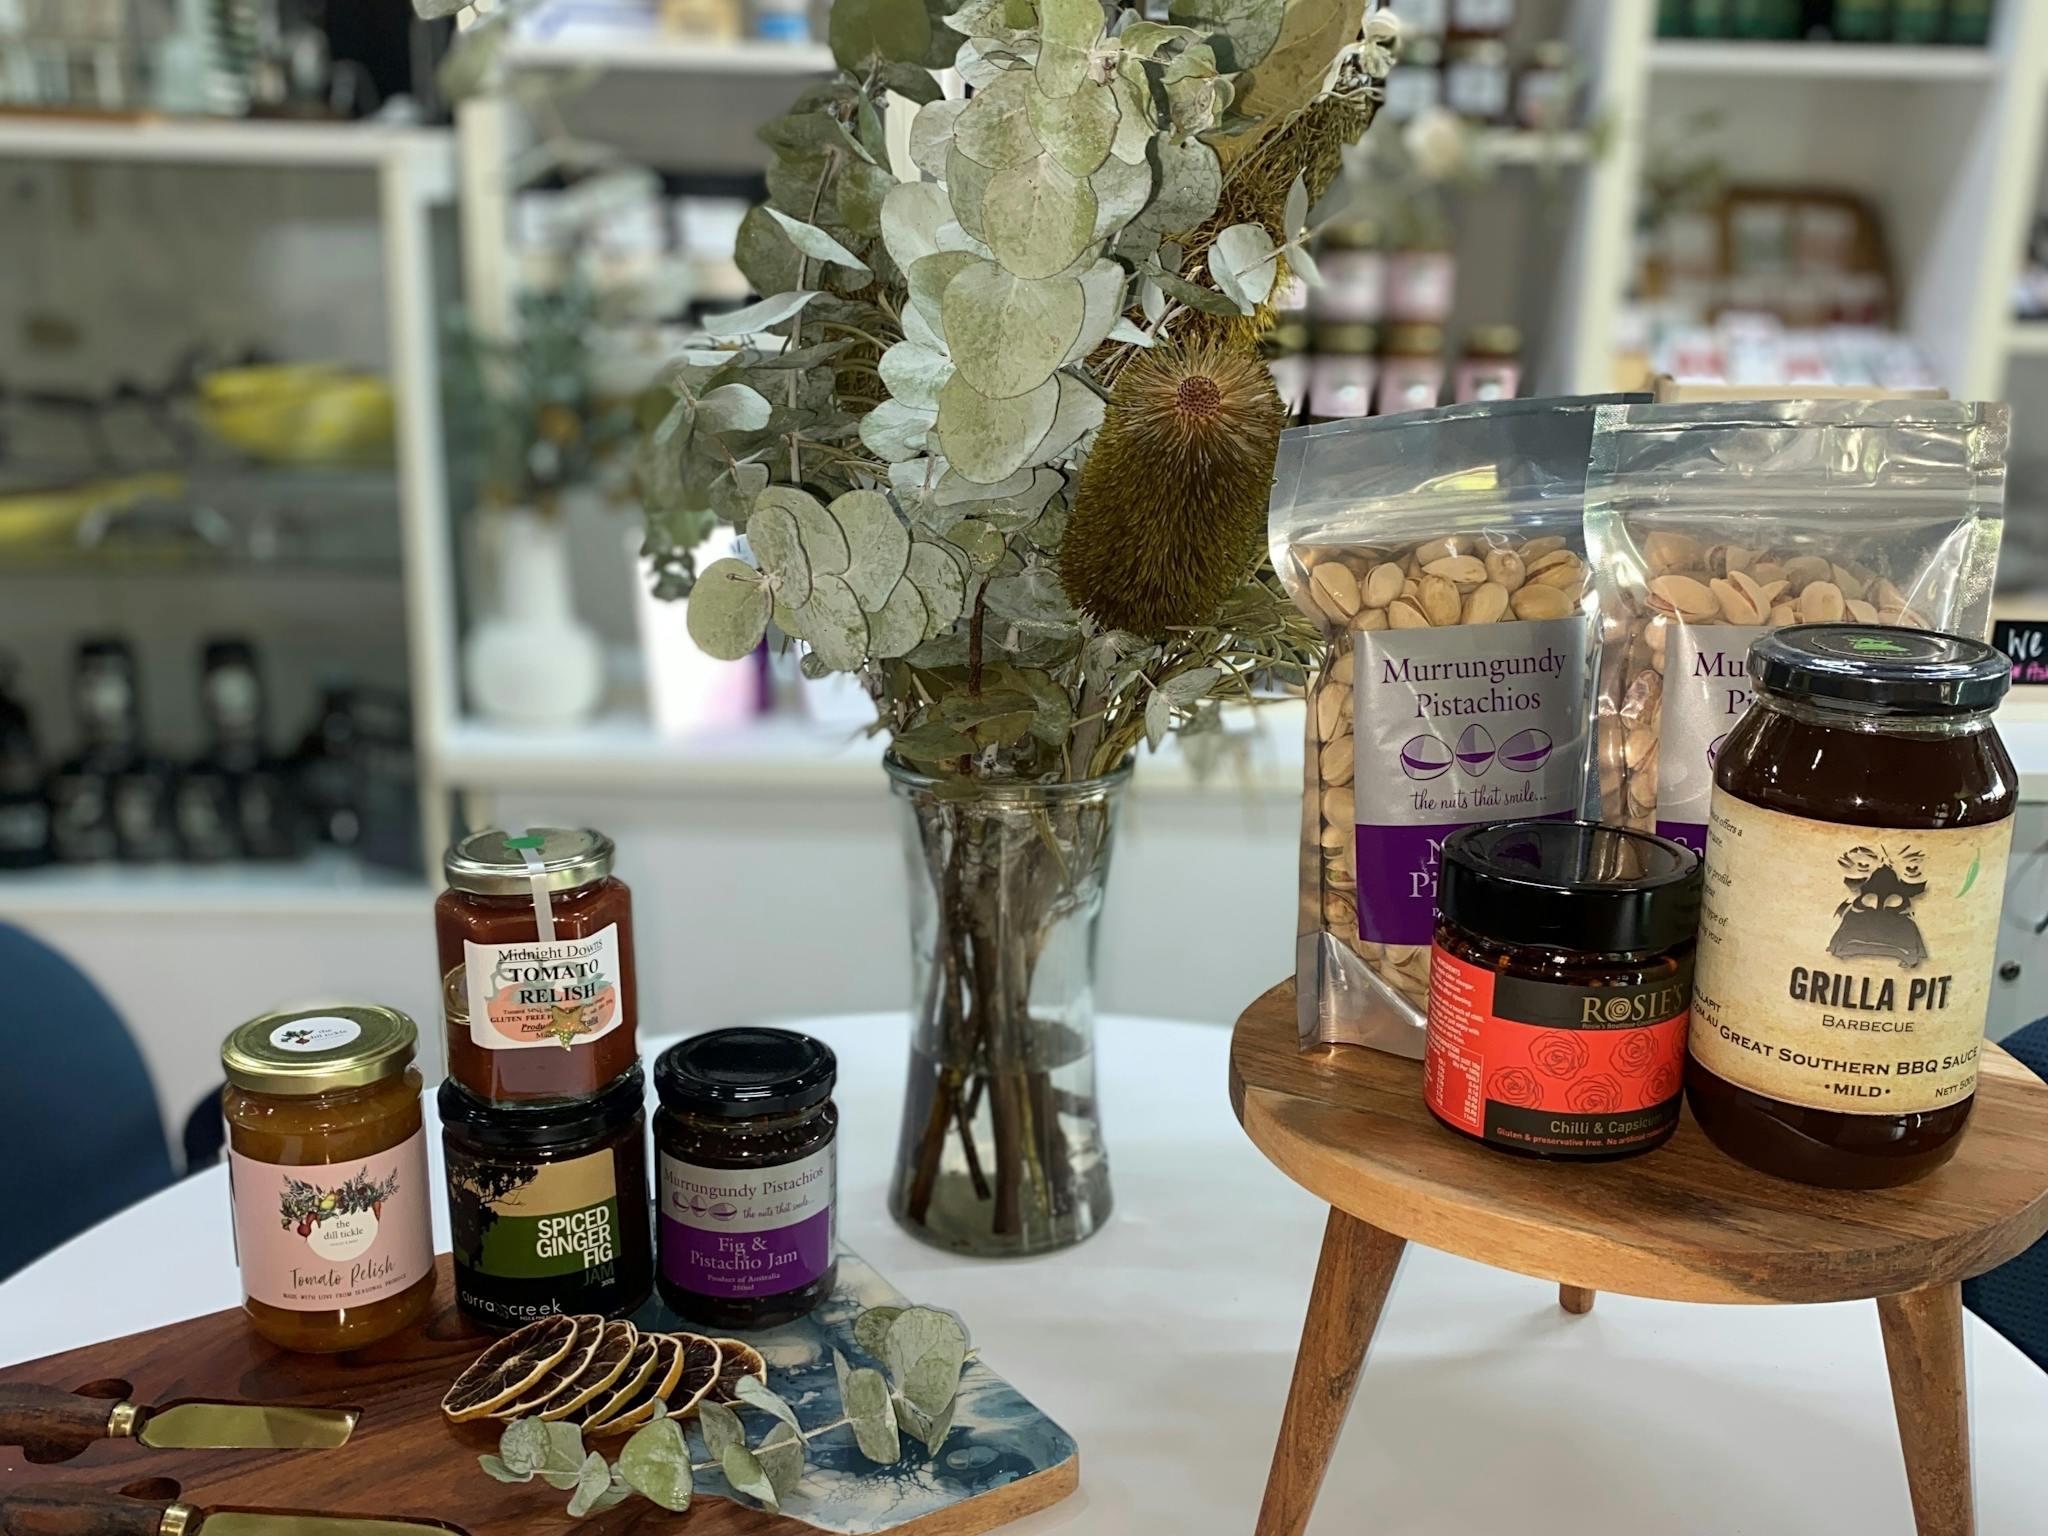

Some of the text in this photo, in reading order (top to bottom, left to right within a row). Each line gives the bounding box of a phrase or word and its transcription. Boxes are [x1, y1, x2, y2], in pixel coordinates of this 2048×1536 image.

[1382, 647, 1567, 684] Murrungundy
[1413, 687, 1541, 718] Pistachios
[1409, 788, 1437, 811] the
[1439, 788, 1469, 809] nuts
[1470, 784, 1502, 808] that
[1737, 828, 1743, 837] a
[498, 941, 603, 961] Midnight Downs
[508, 958, 599, 982] TOMATO
[520, 982, 596, 1004] RELISH
[1790, 966, 1952, 1011] GRILLA PIT
[1580, 983, 1683, 1023] ROSIE'S
[490, 1015, 522, 1024] GLUTEN
[525, 1014, 547, 1022] FREE
[1896, 1059, 1938, 1075] BBQ
[1550, 1120, 1589, 1135] Chilli
[1593, 1122, 1604, 1135] &
[663, 1165, 824, 1200] Murrungundy Pistachios
[323, 1226, 364, 1241] dill tickle
[336, 1219, 350, 1229] the
[537, 1205, 610, 1240] SPICED
[535, 1224, 612, 1259] GINGER
[718, 1236, 768, 1256] Fig &
[583, 1242, 614, 1269] FIG
[690, 1250, 798, 1271] Pistachio Jam
[290, 1255, 396, 1289] Tomato Relish
[583, 1261, 615, 1287] JAM
[462, 1290, 563, 1316] curra creek
